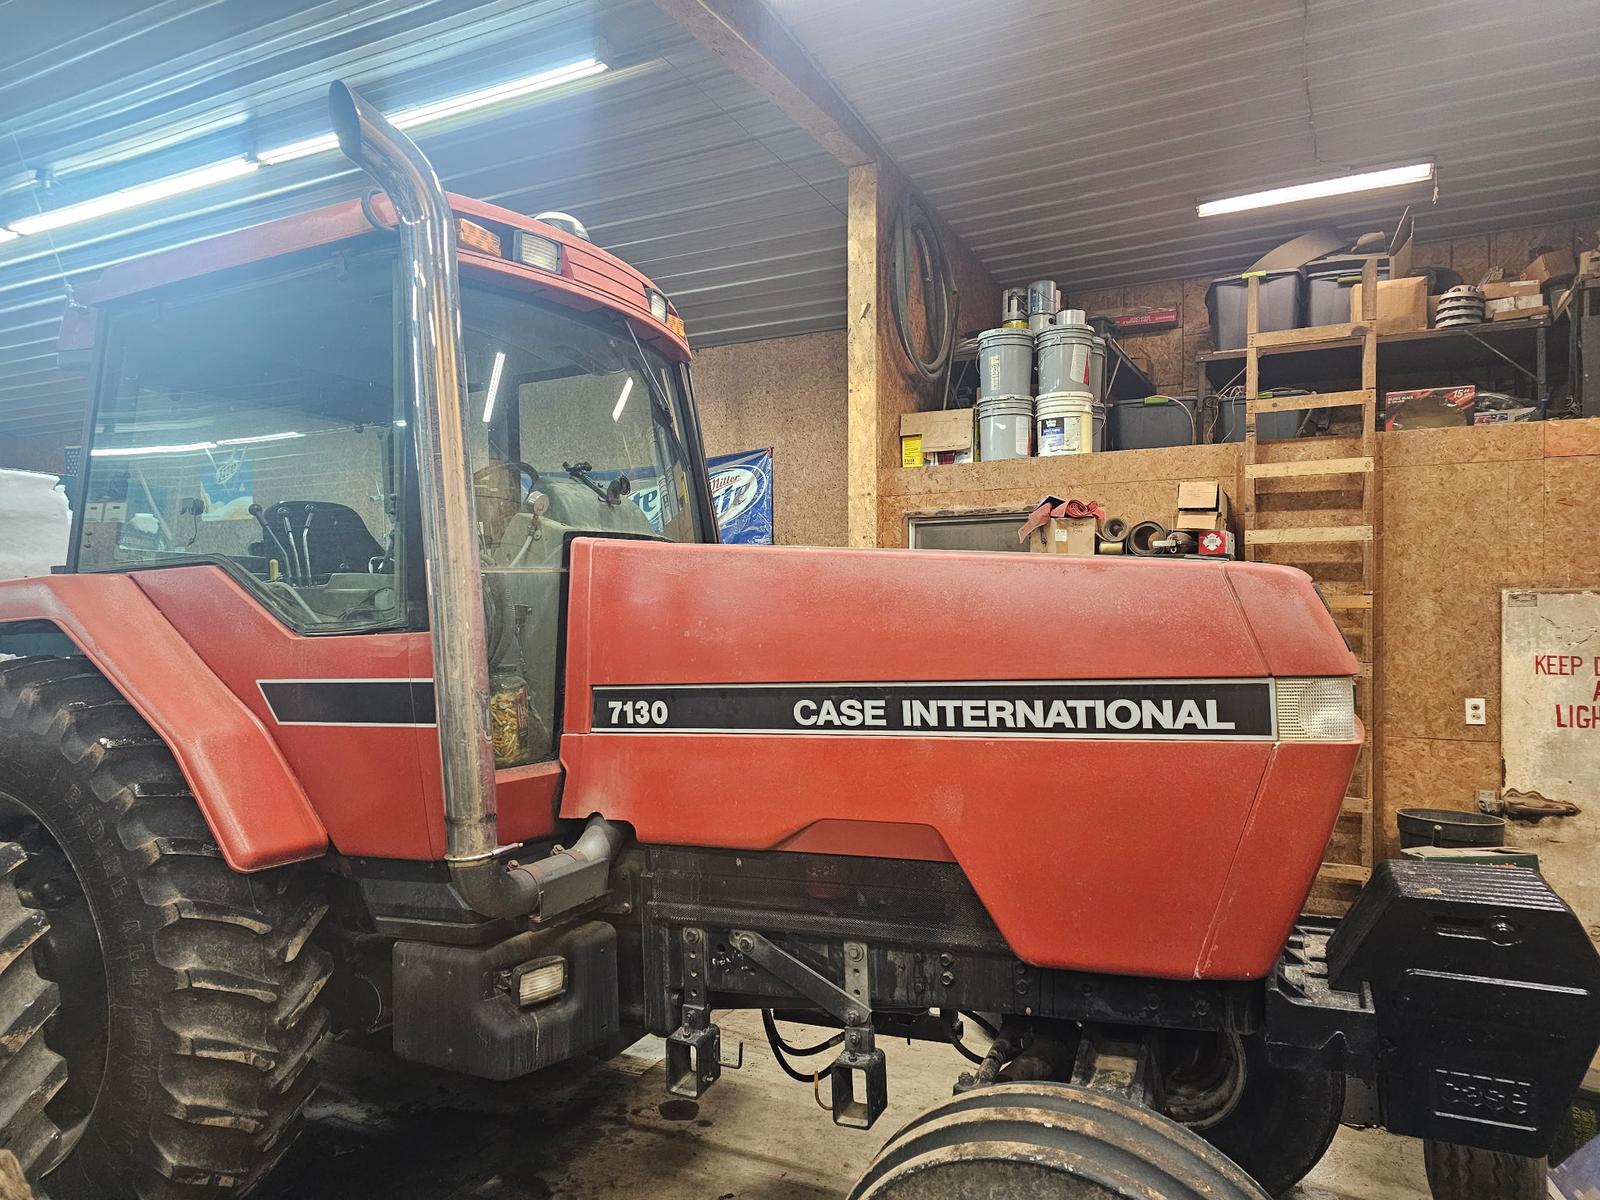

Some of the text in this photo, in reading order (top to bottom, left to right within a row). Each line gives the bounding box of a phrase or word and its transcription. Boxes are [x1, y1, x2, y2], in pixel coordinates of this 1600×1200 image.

[710, 475, 739, 492] Miller
[1535, 655, 1583, 676] KEEP
[608, 700, 669, 725] 7130
[793, 698, 1236, 730] CASE INTERNATIONAL
